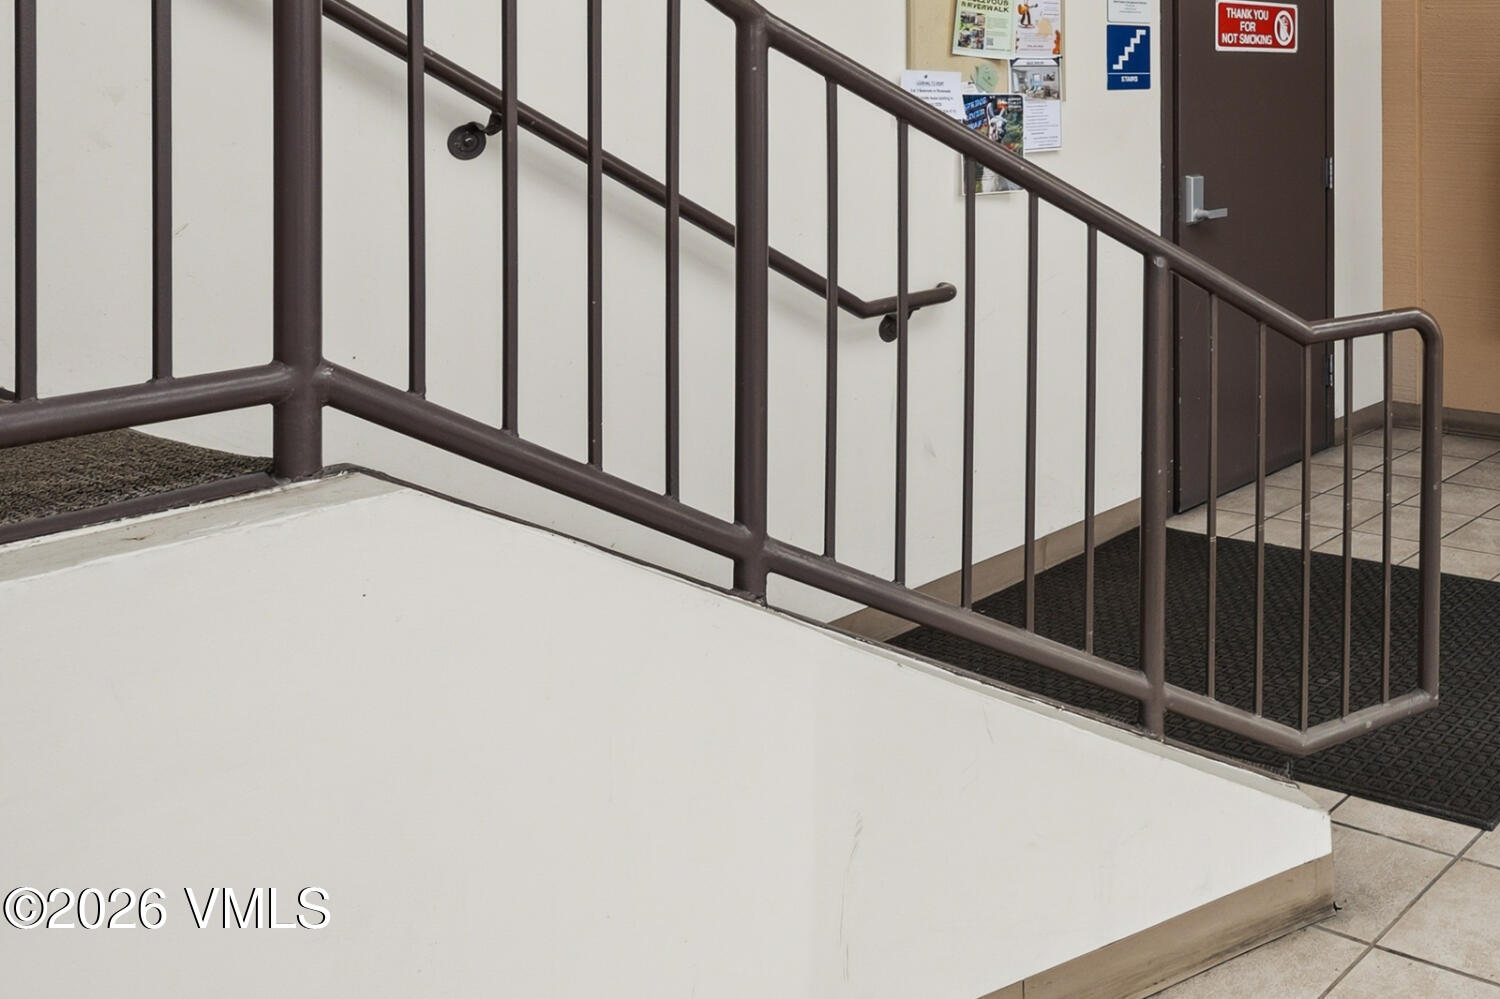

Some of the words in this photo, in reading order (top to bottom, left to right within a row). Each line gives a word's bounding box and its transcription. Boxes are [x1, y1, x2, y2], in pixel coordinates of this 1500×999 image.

[1226, 7, 1253, 20] THANK
[1254, 9, 1269, 21] YOU
[1240, 21, 1257, 32] FOR
[1221, 32, 1239, 44] NOT
[1239, 34, 1273, 46] SMOKING
